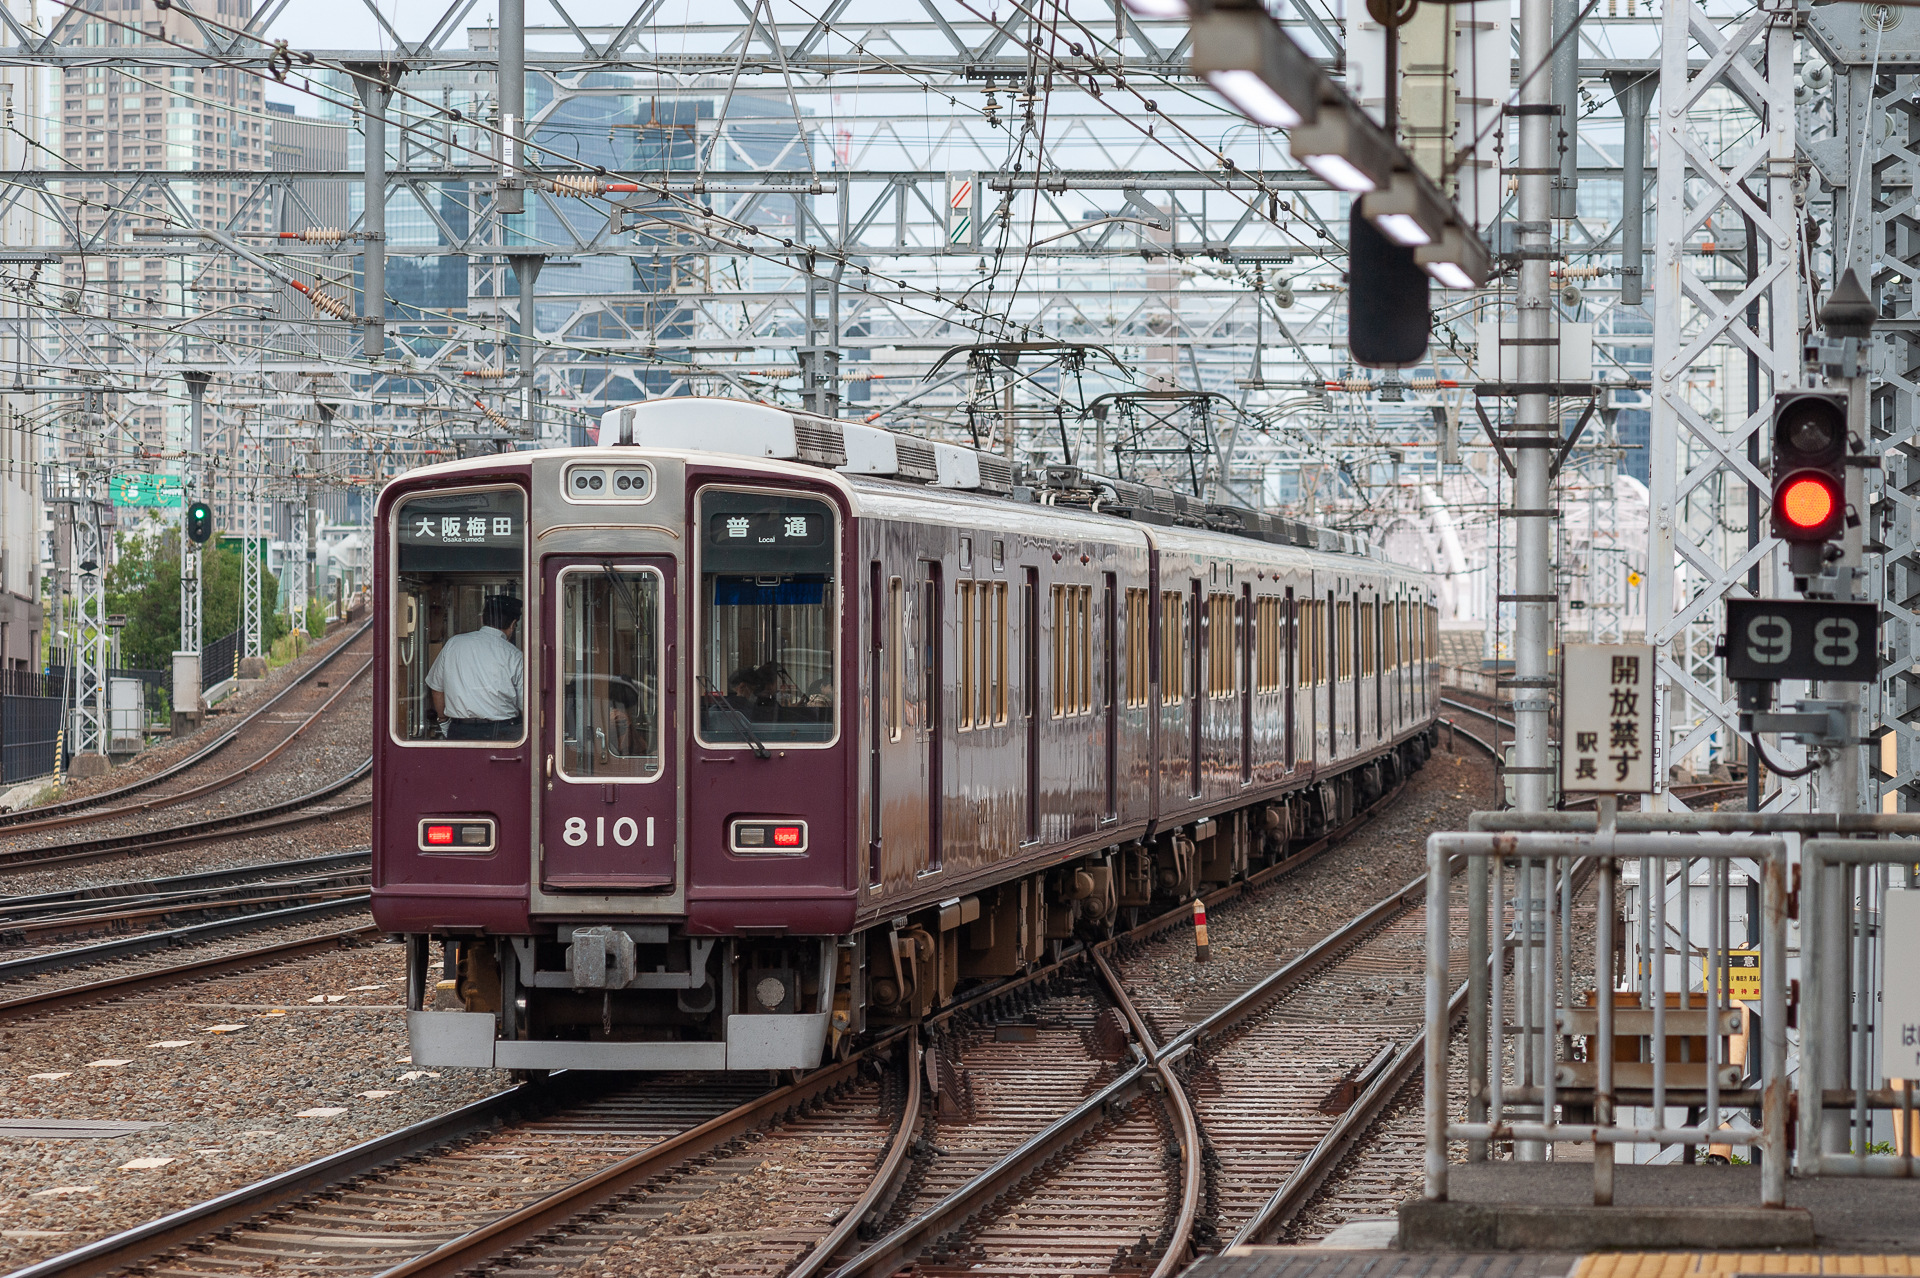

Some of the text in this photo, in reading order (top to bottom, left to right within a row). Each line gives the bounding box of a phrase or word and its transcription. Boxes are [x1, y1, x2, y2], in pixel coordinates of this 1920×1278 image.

[415, 517, 512, 537] 大阪梅田
[726, 517, 807, 537] 普通
[1747, 615, 1859, 666] 98
[1608, 655, 1641, 782] 開放禁ず
[1575, 731, 1598, 780] 駅長
[562, 816, 655, 847] 8101
